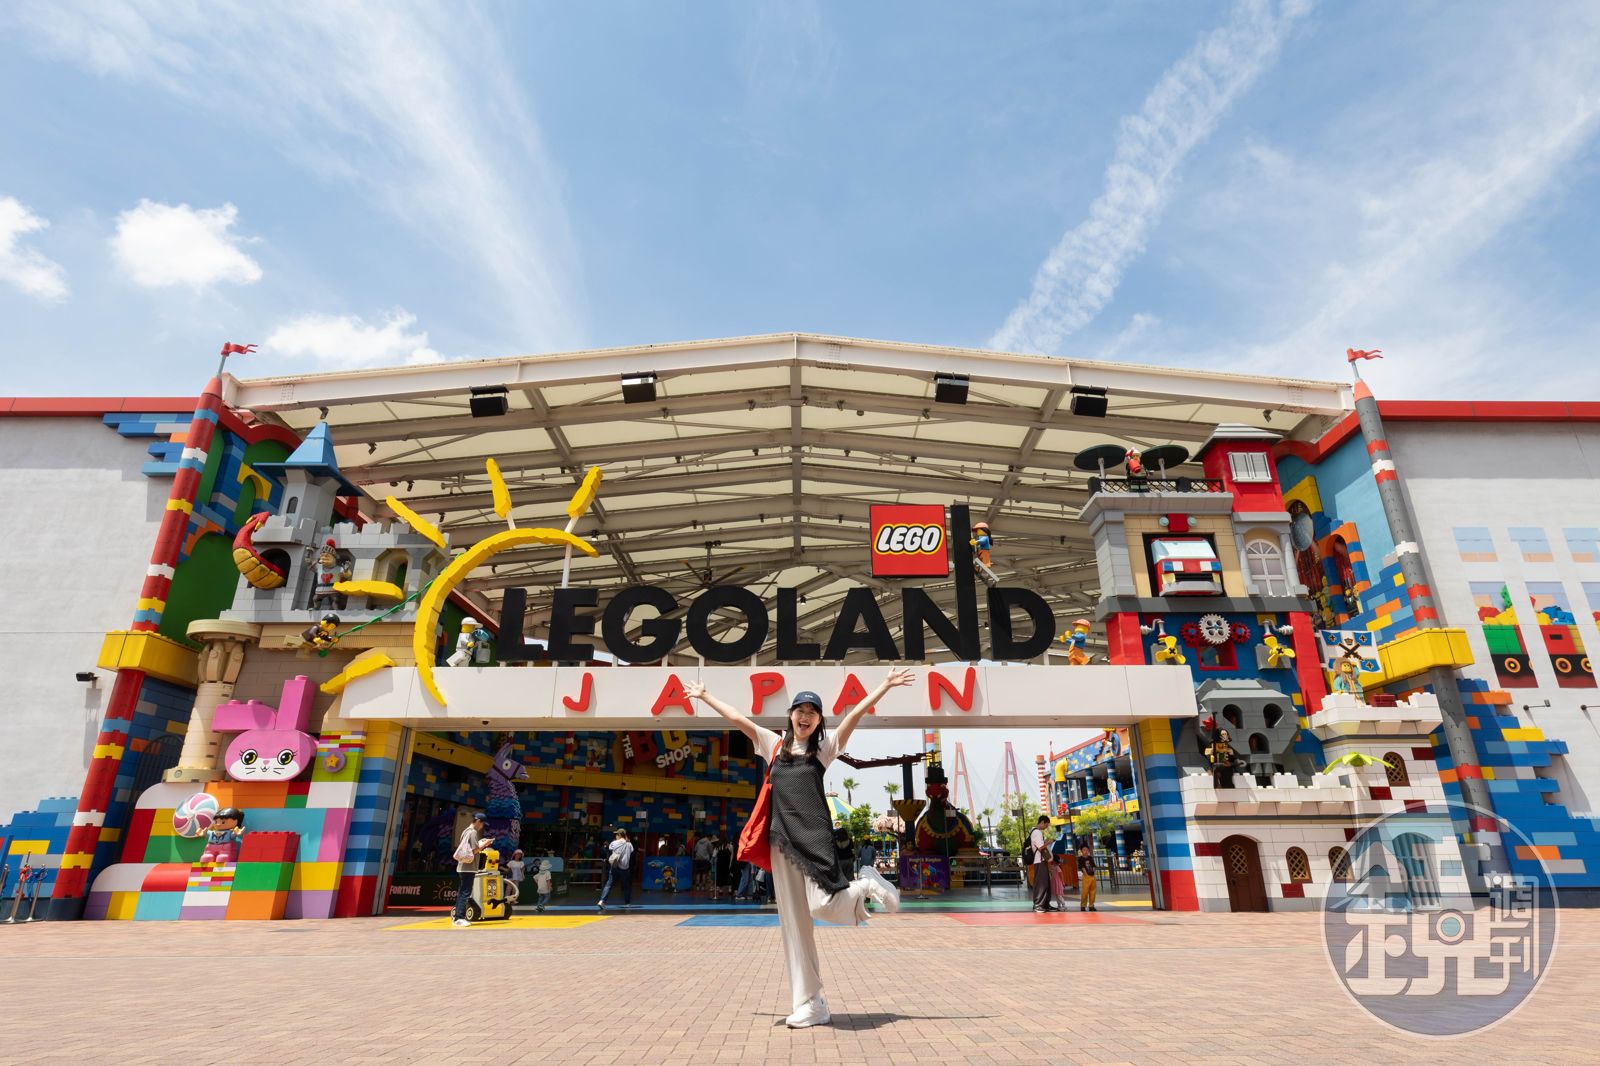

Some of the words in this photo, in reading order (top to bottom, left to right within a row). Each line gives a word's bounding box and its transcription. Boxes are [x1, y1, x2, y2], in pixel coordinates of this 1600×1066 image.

[875, 524, 943, 554] LEGO
[498, 504, 1056, 663] LEGOLAND
[562, 666, 977, 716] JAPAN
[621, 735, 634, 759] THE
[655, 745, 692, 769] SHOP
[389, 885, 422, 896] FORTNITE
